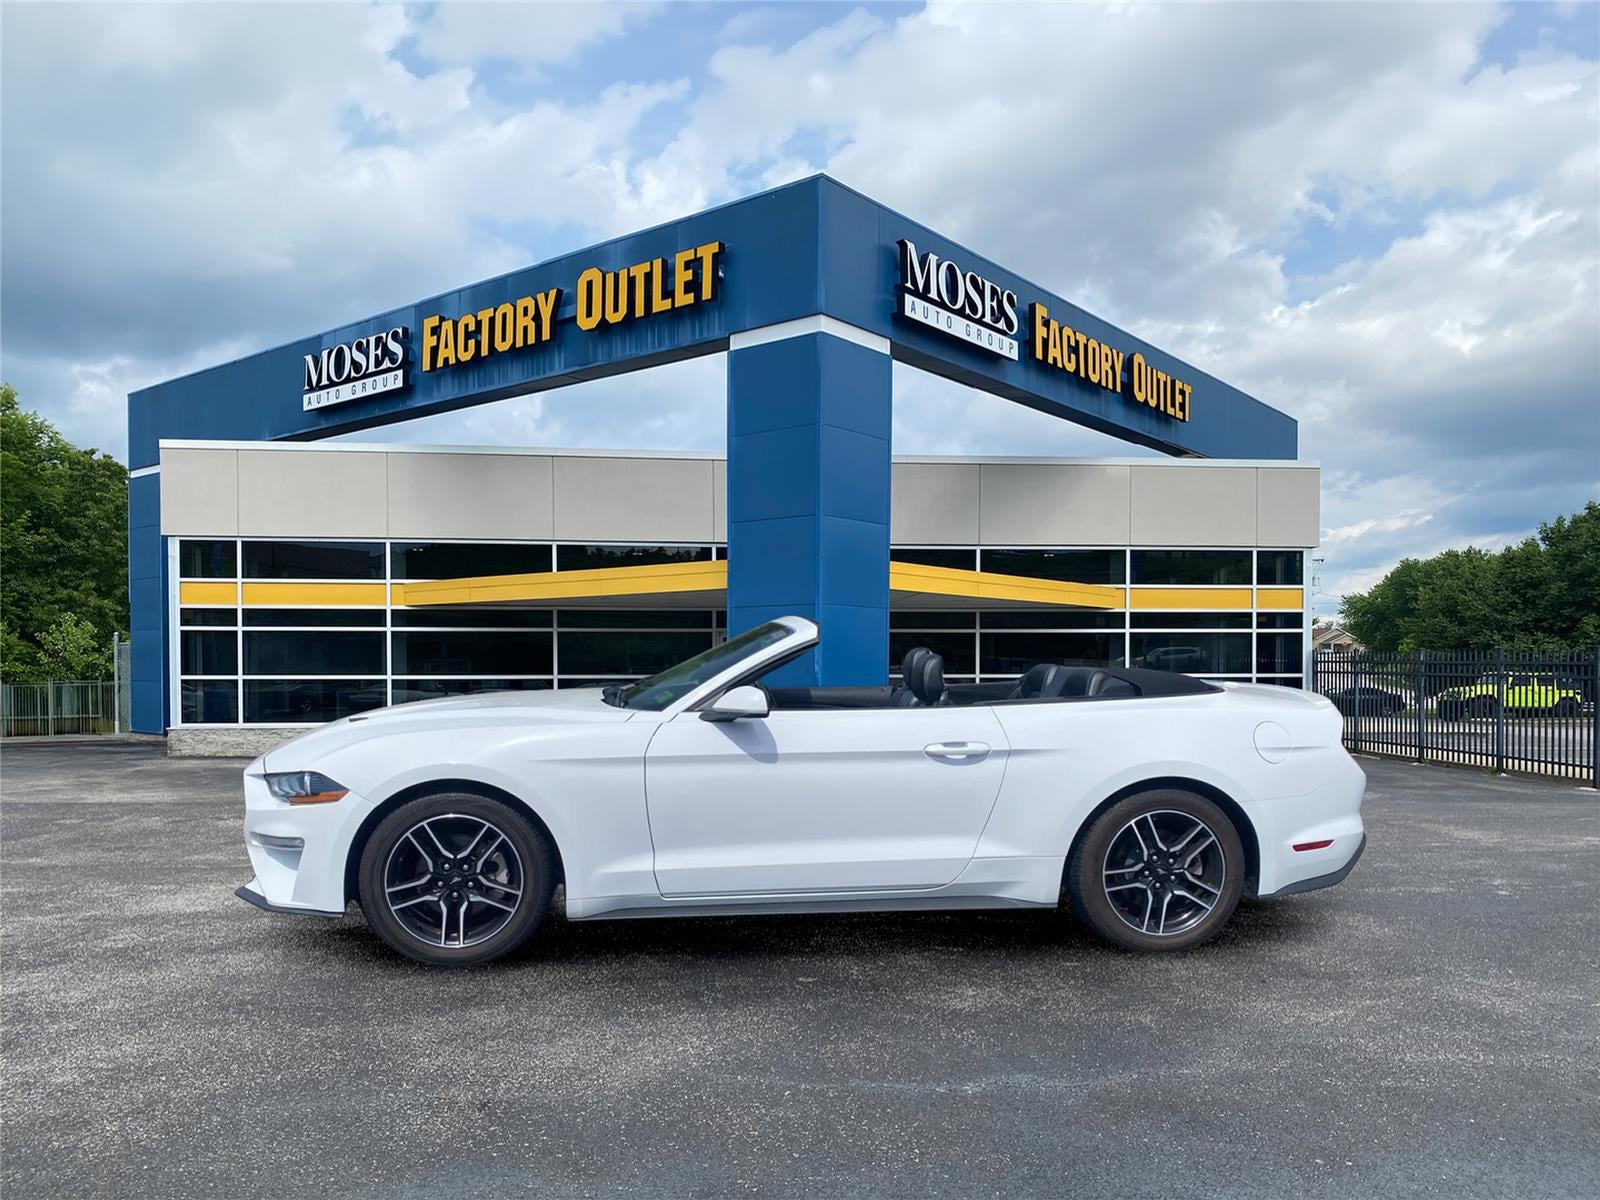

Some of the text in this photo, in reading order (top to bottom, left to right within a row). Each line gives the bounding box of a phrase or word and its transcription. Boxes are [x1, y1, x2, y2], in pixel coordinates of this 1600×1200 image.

[422, 241, 721, 372] FACTORY OUTLET
[904, 239, 1019, 335] MOSES
[303, 327, 404, 391] MOSES
[910, 301, 1015, 354] AUTO GROUP
[1035, 302, 1192, 422] FACTORY OUTLET
[307, 374, 400, 407] AUTO GROUP
